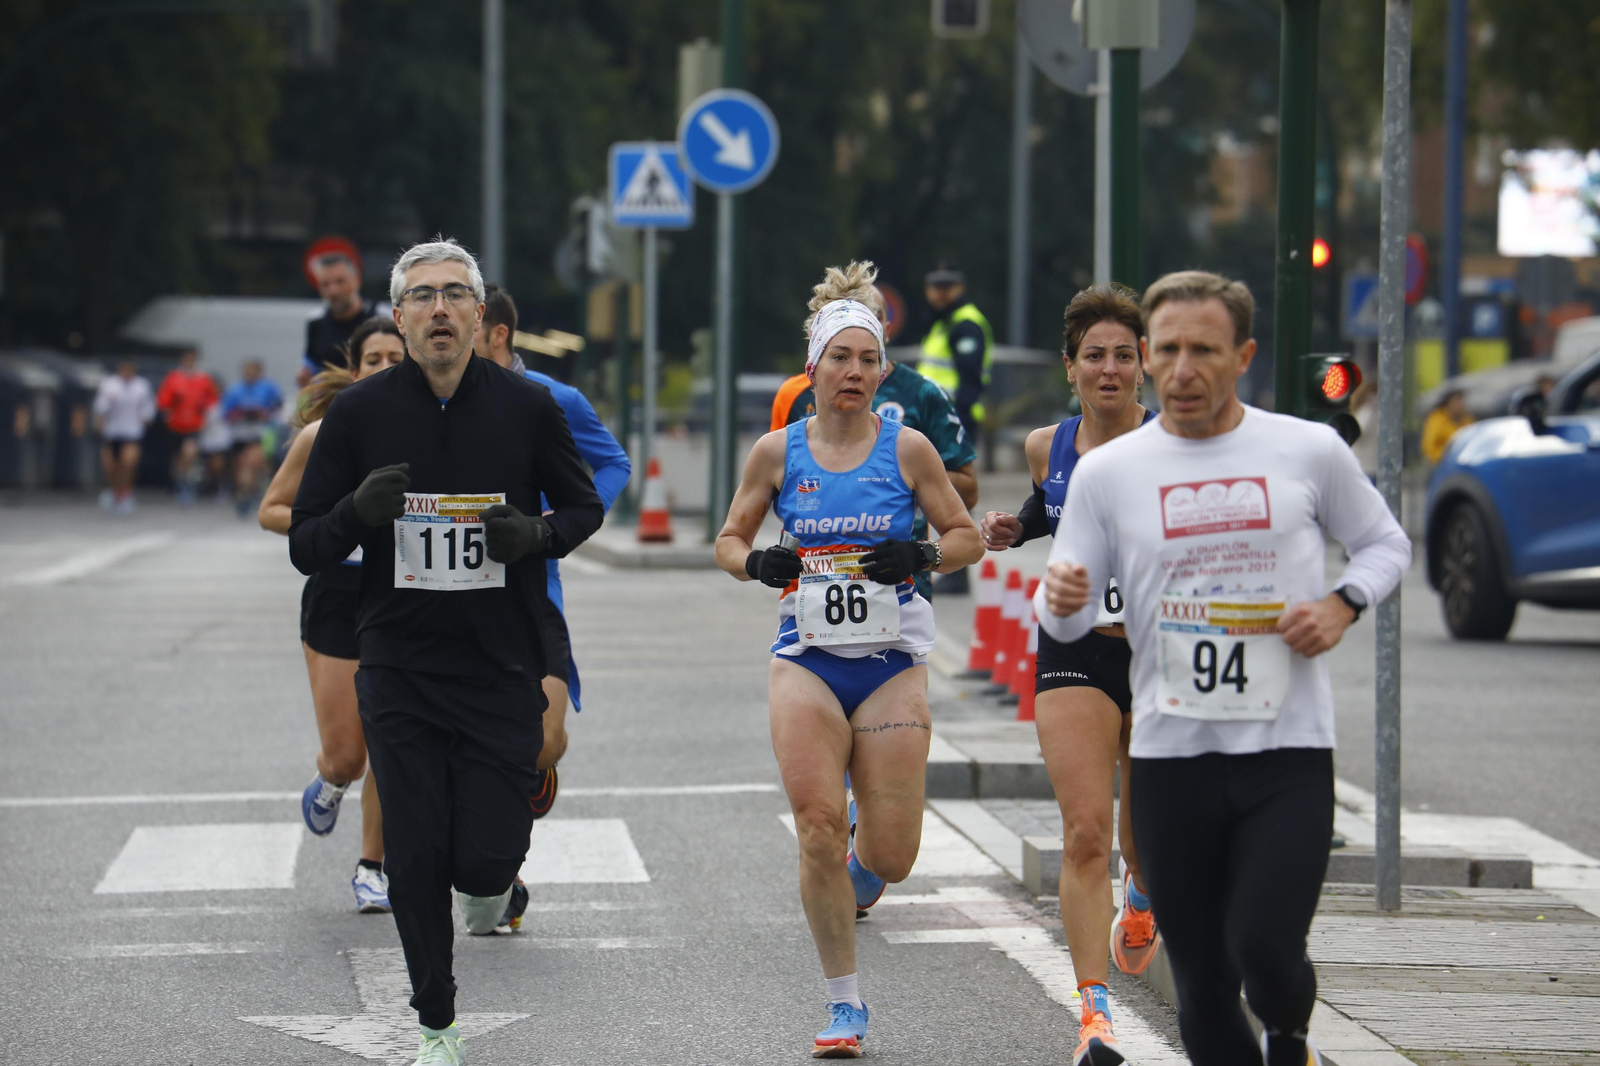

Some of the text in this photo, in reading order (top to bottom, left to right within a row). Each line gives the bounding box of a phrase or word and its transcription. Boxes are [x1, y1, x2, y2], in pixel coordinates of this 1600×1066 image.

[404, 497, 438, 514] XXIX
[1045, 504, 1063, 518] TRO
[794, 512, 893, 535] enerplus
[420, 527, 484, 570] 115
[1203, 554, 1217, 563] DE
[1221, 550, 1277, 561] MONTILLA
[1198, 564, 1244, 576] febrero
[1247, 561, 1277, 573] 2017
[825, 583, 868, 625] 86
[1160, 600, 1208, 621] XXXIX
[1041, 671, 1089, 680] TROTASIERRA
[1193, 640, 1248, 694] 94
